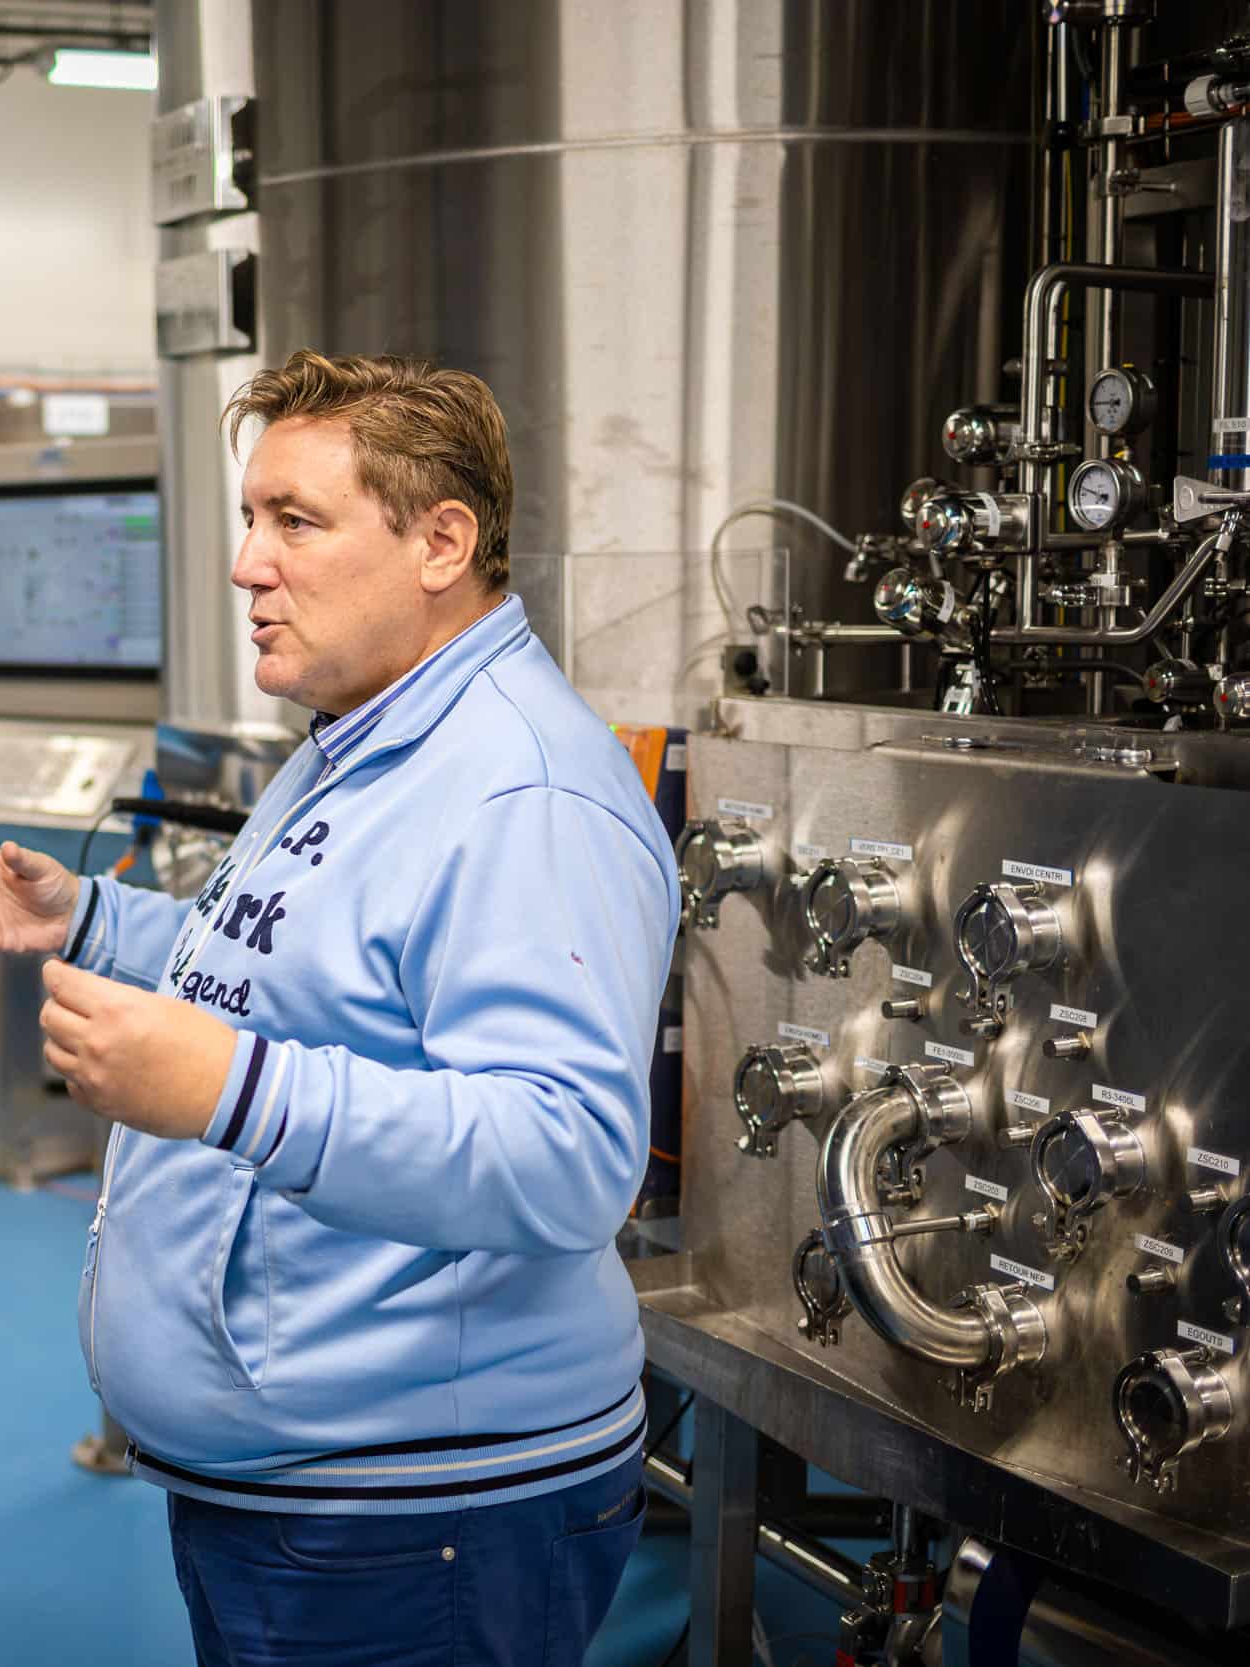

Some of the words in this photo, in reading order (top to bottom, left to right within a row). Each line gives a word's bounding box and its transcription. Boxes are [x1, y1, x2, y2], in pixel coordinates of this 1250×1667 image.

[1197, 1152, 1229, 1169] ZSC210
[1143, 1239, 1174, 1257] ZSC209
[999, 1259, 1029, 1278] RETOUR
